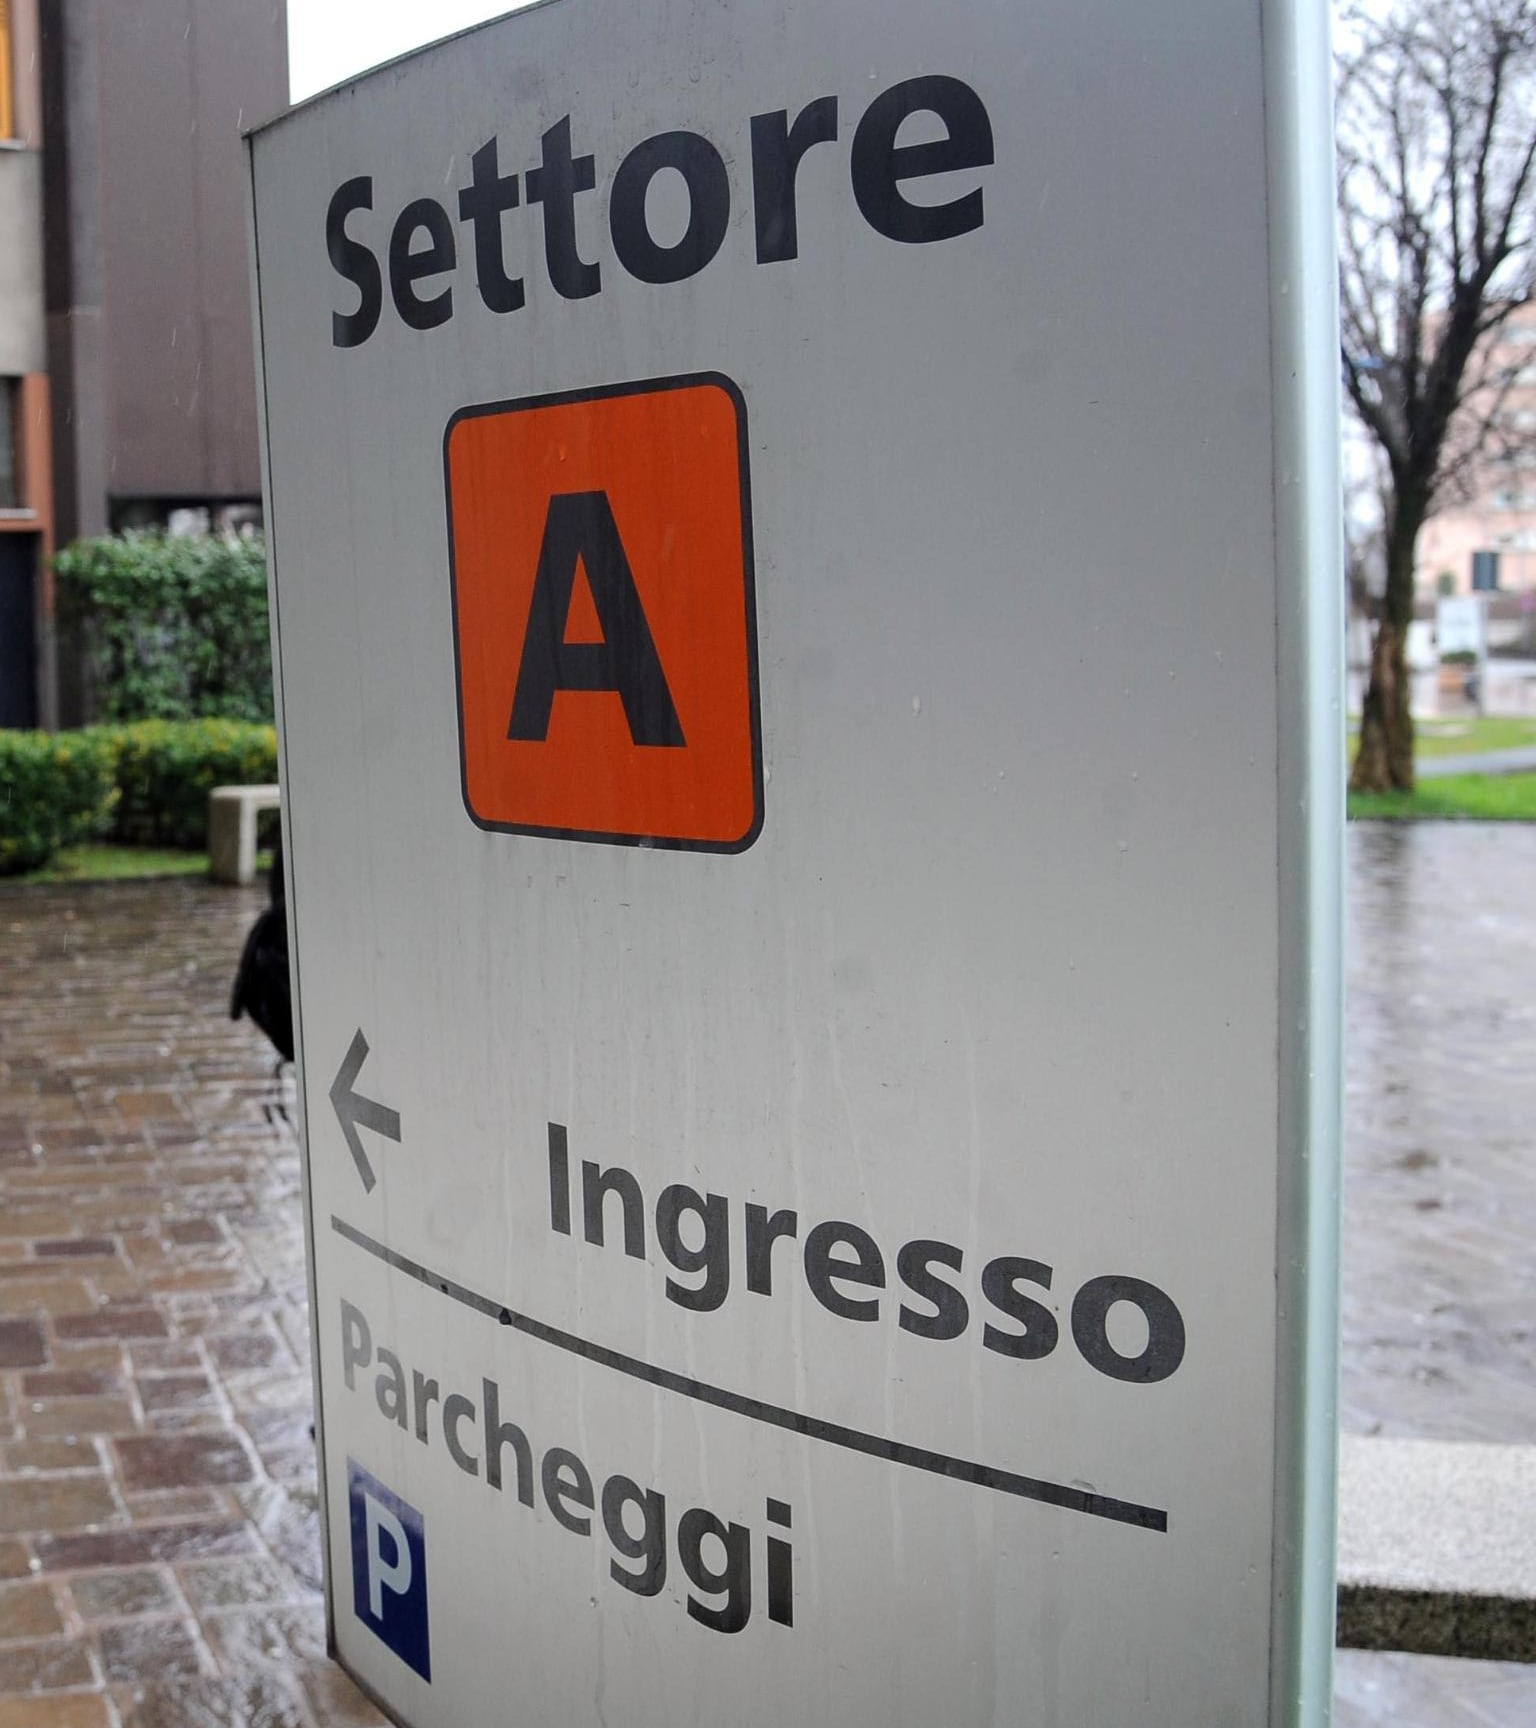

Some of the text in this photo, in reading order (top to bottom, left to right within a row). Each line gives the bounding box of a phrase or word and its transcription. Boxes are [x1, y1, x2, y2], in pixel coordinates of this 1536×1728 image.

[325, 74, 995, 348] Settore
[506, 489, 687, 748] A
[547, 1121, 1187, 1384] Ingresso
[339, 1298, 795, 1635] Parcheggi
[364, 1492, 412, 1621] P
